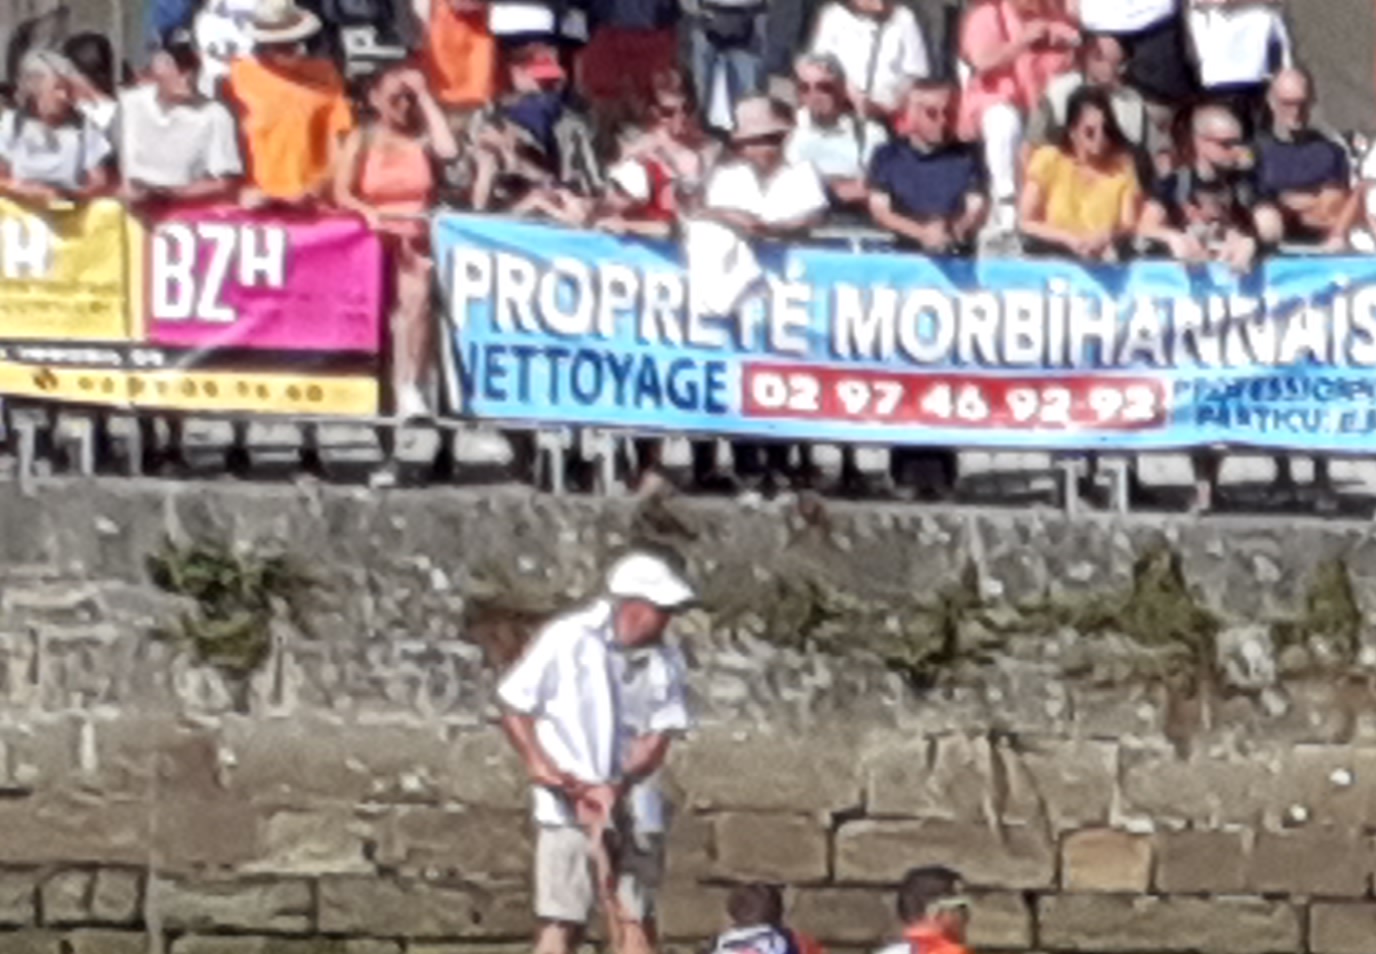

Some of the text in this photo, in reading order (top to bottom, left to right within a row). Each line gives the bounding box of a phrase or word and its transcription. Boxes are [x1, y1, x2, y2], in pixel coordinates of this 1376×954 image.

[152, 221, 287, 322] BZH
[462, 341, 728, 414] NETTOYAGE
[751, 372, 1156, 425] 02 97 46 92 92
